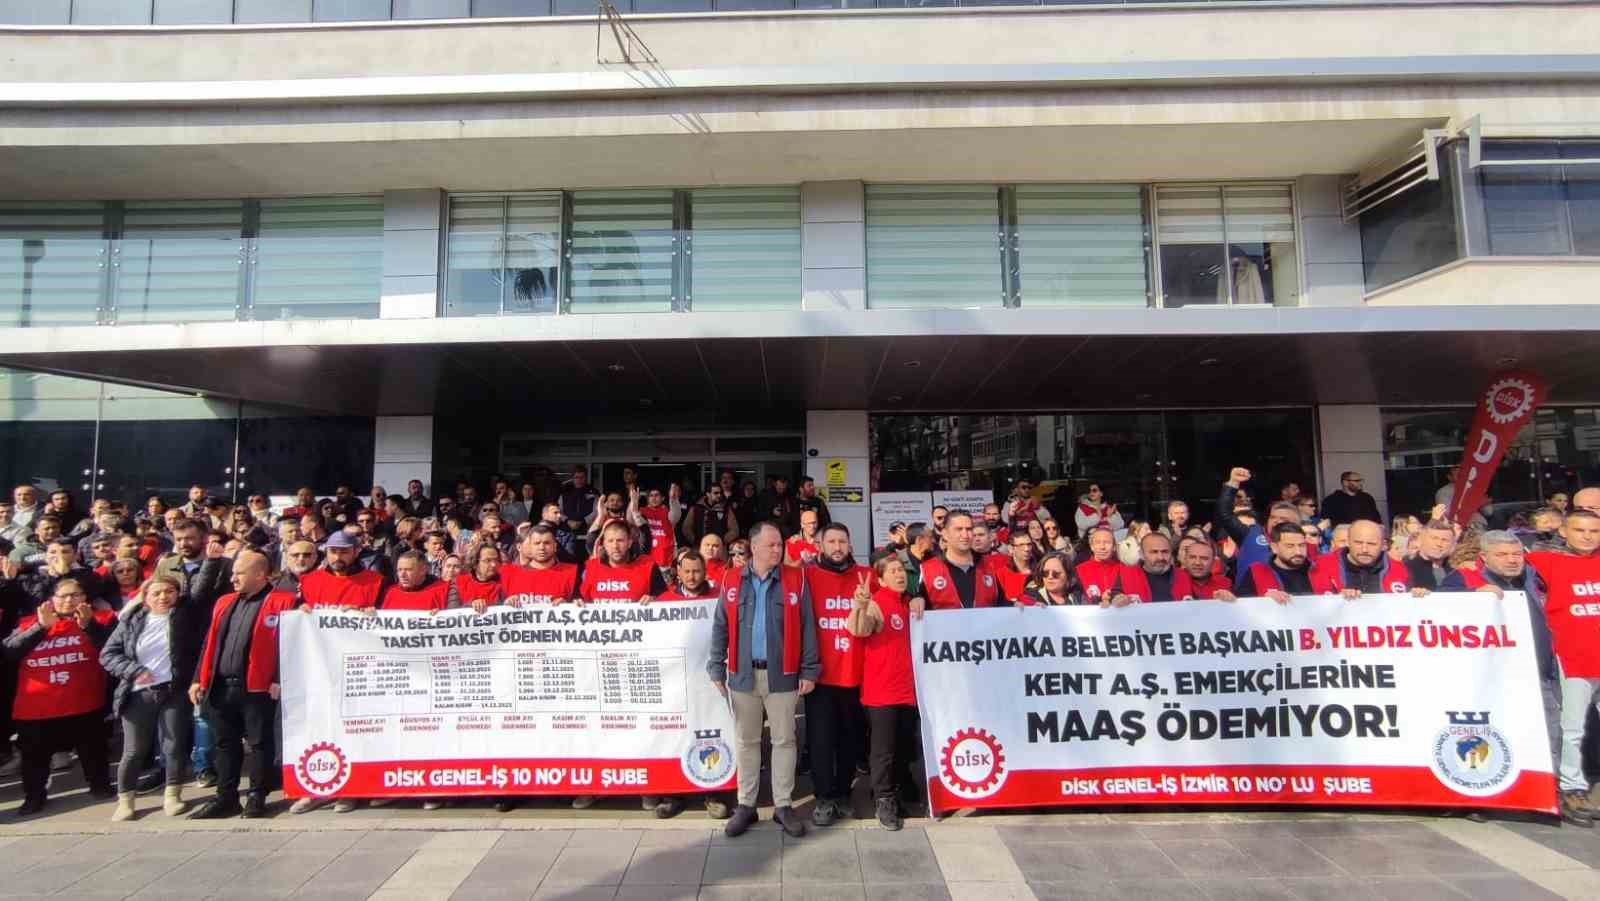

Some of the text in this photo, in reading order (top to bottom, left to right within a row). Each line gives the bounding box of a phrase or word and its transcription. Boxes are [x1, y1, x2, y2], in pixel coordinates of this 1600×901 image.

[597, 579, 629, 591] DİSK
[1572, 581, 1600, 595] DİS
[501, 610, 543, 624] KENT
[547, 609, 575, 625] A.Ş.
[579, 606, 708, 626] ÇALIŞANLARINA
[818, 617, 849, 629] GEN
[381, 627, 642, 648] TAKSİT TAKSİT ÖDENEN MAAŞLAR
[834, 634, 850, 652] İŞ
[923, 620, 1517, 665] KARŞIYAKA BELEDİYE BAŞKANI B. YILDIZ ÜNSAL
[26, 651, 89, 668] GENEL
[49, 670, 70, 685] İŞ
[1025, 659, 1396, 699] KENT A.Ş. EMEKÇİLERİNE
[1028, 698, 1400, 746] MAAŞ ÖDEMİYOR!
[309, 758, 337, 772] DİSK
[955, 750, 991, 768] DİSK
[384, 768, 426, 787] DİSK
[430, 764, 508, 789] GENEL-İŞ
[512, 769, 531, 783] 10
[571, 769, 592, 783] LU
[601, 768, 648, 788] ŞUBE
[1061, 777, 1100, 795] DİSK
[1103, 775, 1177, 796] GENEL-İŞ
[1182, 773, 1228, 793] İZMİR
[1232, 776, 1252, 793] 10
[1292, 776, 1314, 792] LU
[1323, 776, 1372, 795] ŞUBE
